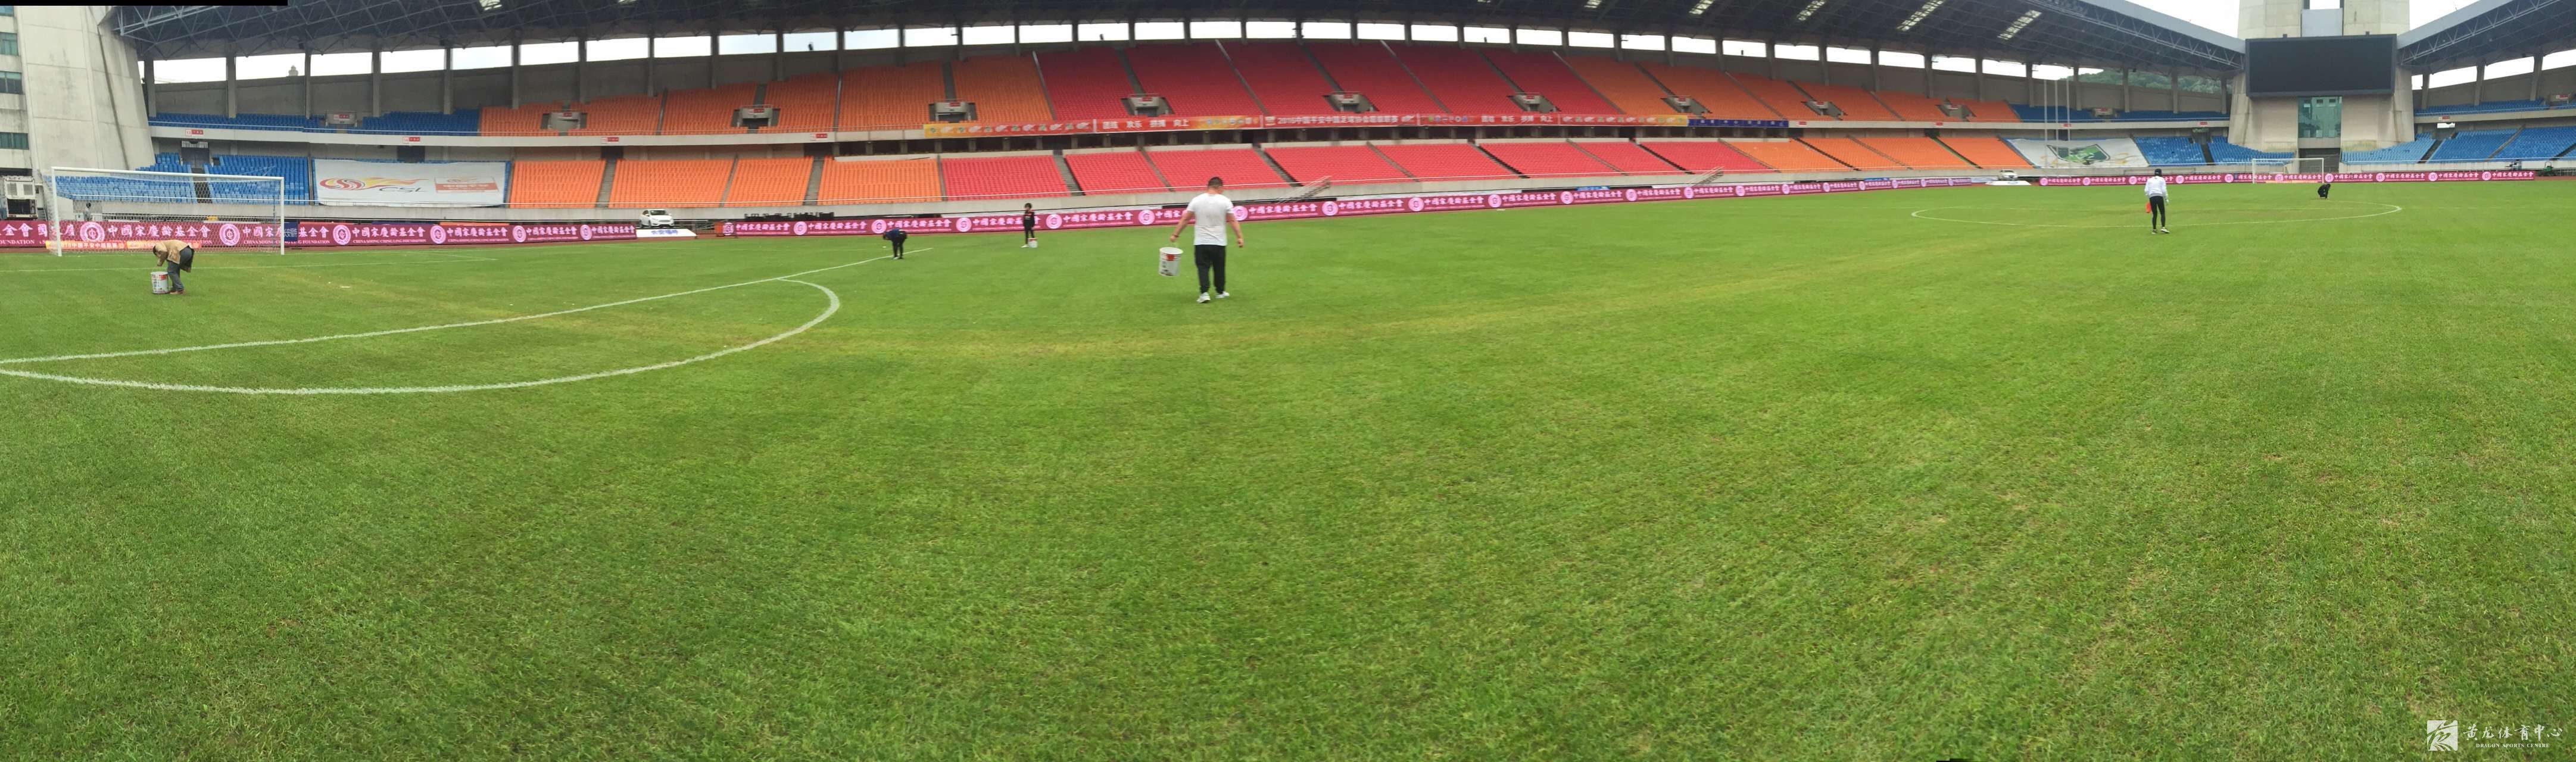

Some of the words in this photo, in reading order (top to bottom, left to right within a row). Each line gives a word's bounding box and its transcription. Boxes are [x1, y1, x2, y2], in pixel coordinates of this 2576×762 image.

[0, 223, 33, 237] 金會
[299, 227, 329, 238] 基金會
[353, 227, 425, 238] 中國宋慶齡基金會
[447, 226, 507, 237] 中國宋慶齡基金會
